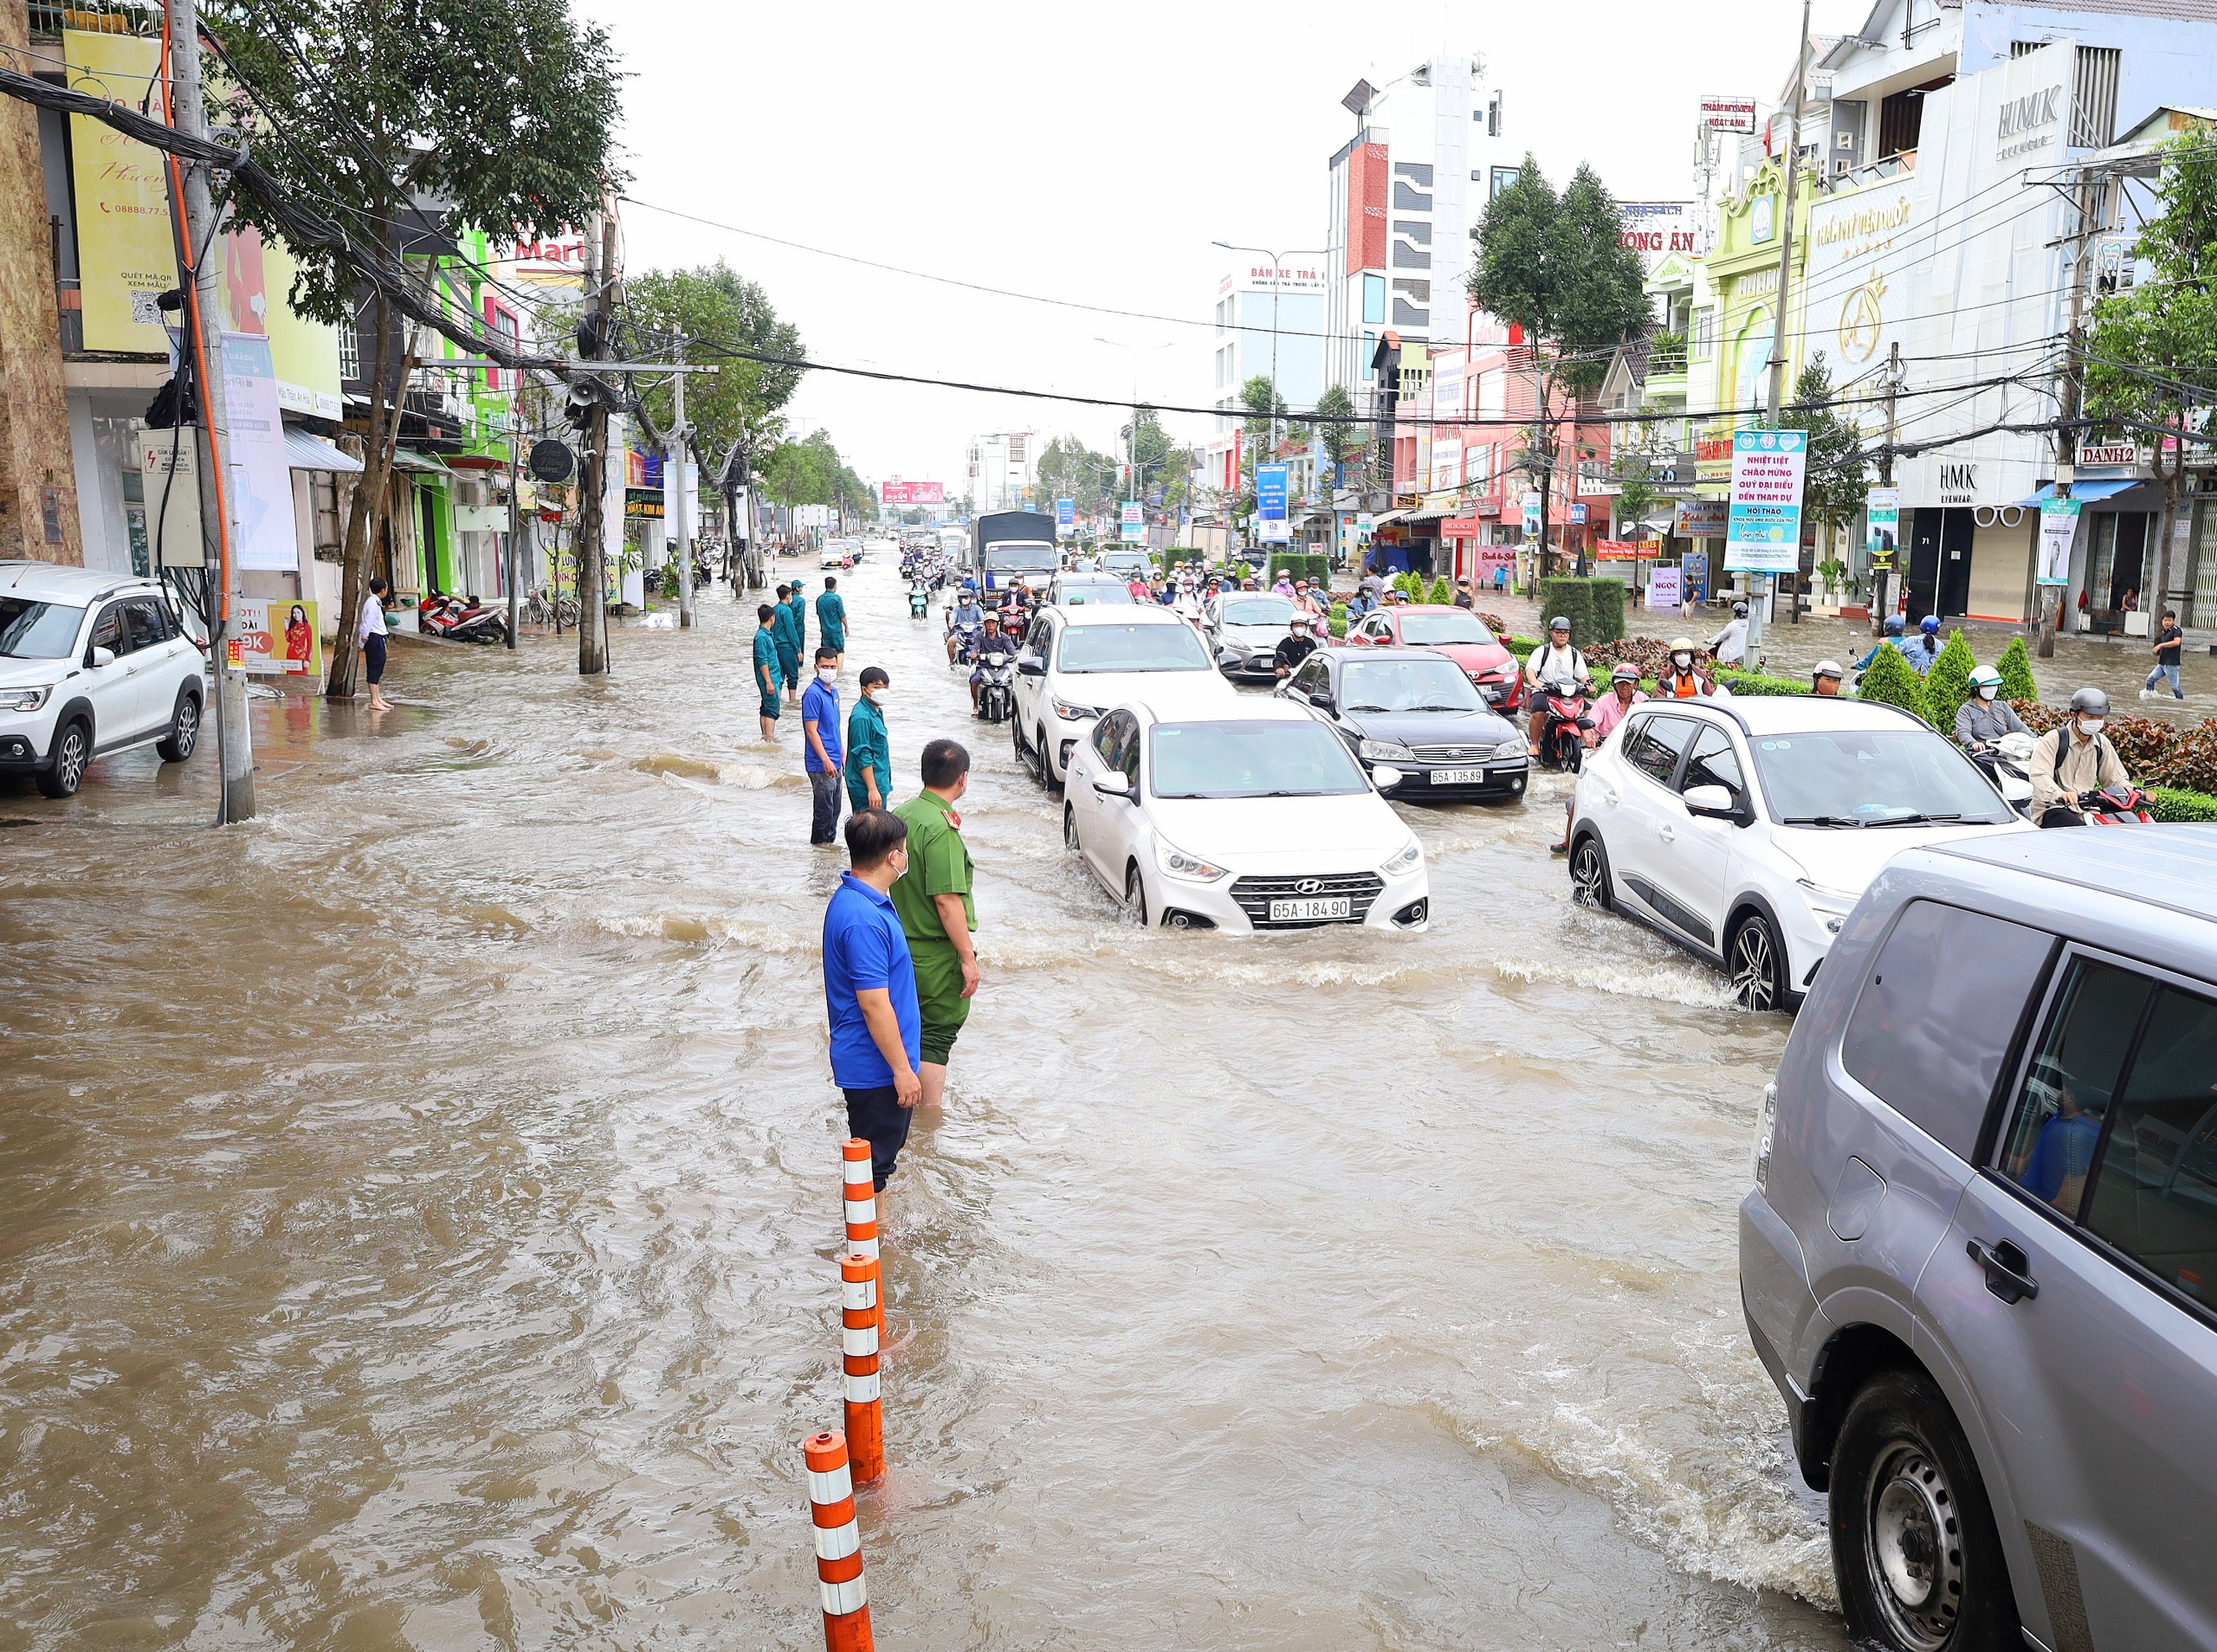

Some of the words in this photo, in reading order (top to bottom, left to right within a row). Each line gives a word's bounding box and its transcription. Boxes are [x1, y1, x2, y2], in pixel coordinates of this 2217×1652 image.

[1998, 85, 2061, 139] HMK
[1251, 266, 1273, 278] BÁN
[1278, 269, 1291, 279] XE
[1747, 455, 1772, 466] NHIỆT
[1773, 455, 1790, 467] LIỆT
[1742, 467, 1766, 476] CHÀO
[1767, 468, 1793, 477] MỪNG
[1940, 464, 1978, 490] HMK
[1774, 479, 1794, 489] BIỂU
[1781, 494, 1793, 504] DỰ
[1941, 494, 1974, 504] EYEWEAR
[1761, 506, 1782, 515] THẢO
[1269, 521, 1278, 531] ila
[1655, 582, 1677, 590] NGỌC
[243, 635, 264, 650] 9K
[1432, 771, 1482, 784] 65A-135.89
[1273, 900, 1348, 918] 65A-184.90
